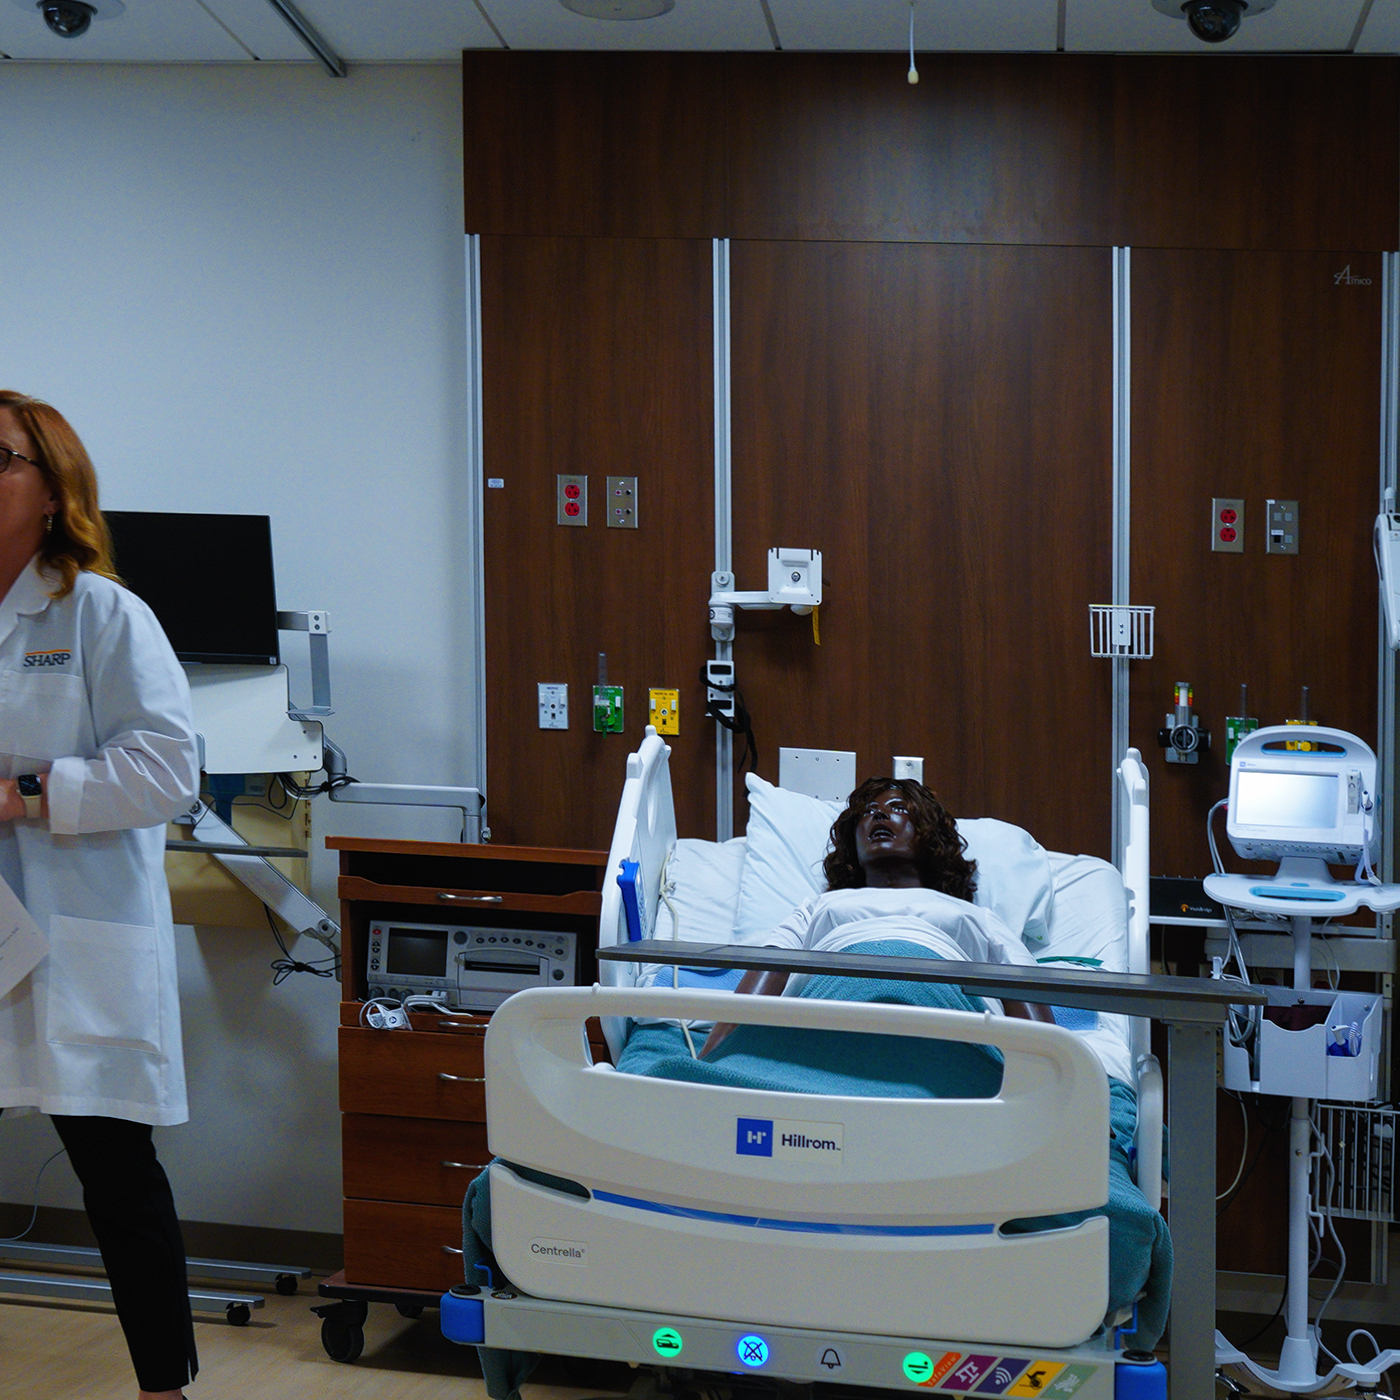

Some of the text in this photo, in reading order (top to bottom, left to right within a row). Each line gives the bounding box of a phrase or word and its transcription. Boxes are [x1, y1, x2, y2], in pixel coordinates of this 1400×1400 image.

[23, 653, 71, 667] SHARP
[781, 1133, 836, 1150] Hillrom
[531, 1243, 581, 1258] Centrella
[926, 1353, 958, 1387] SafeView
